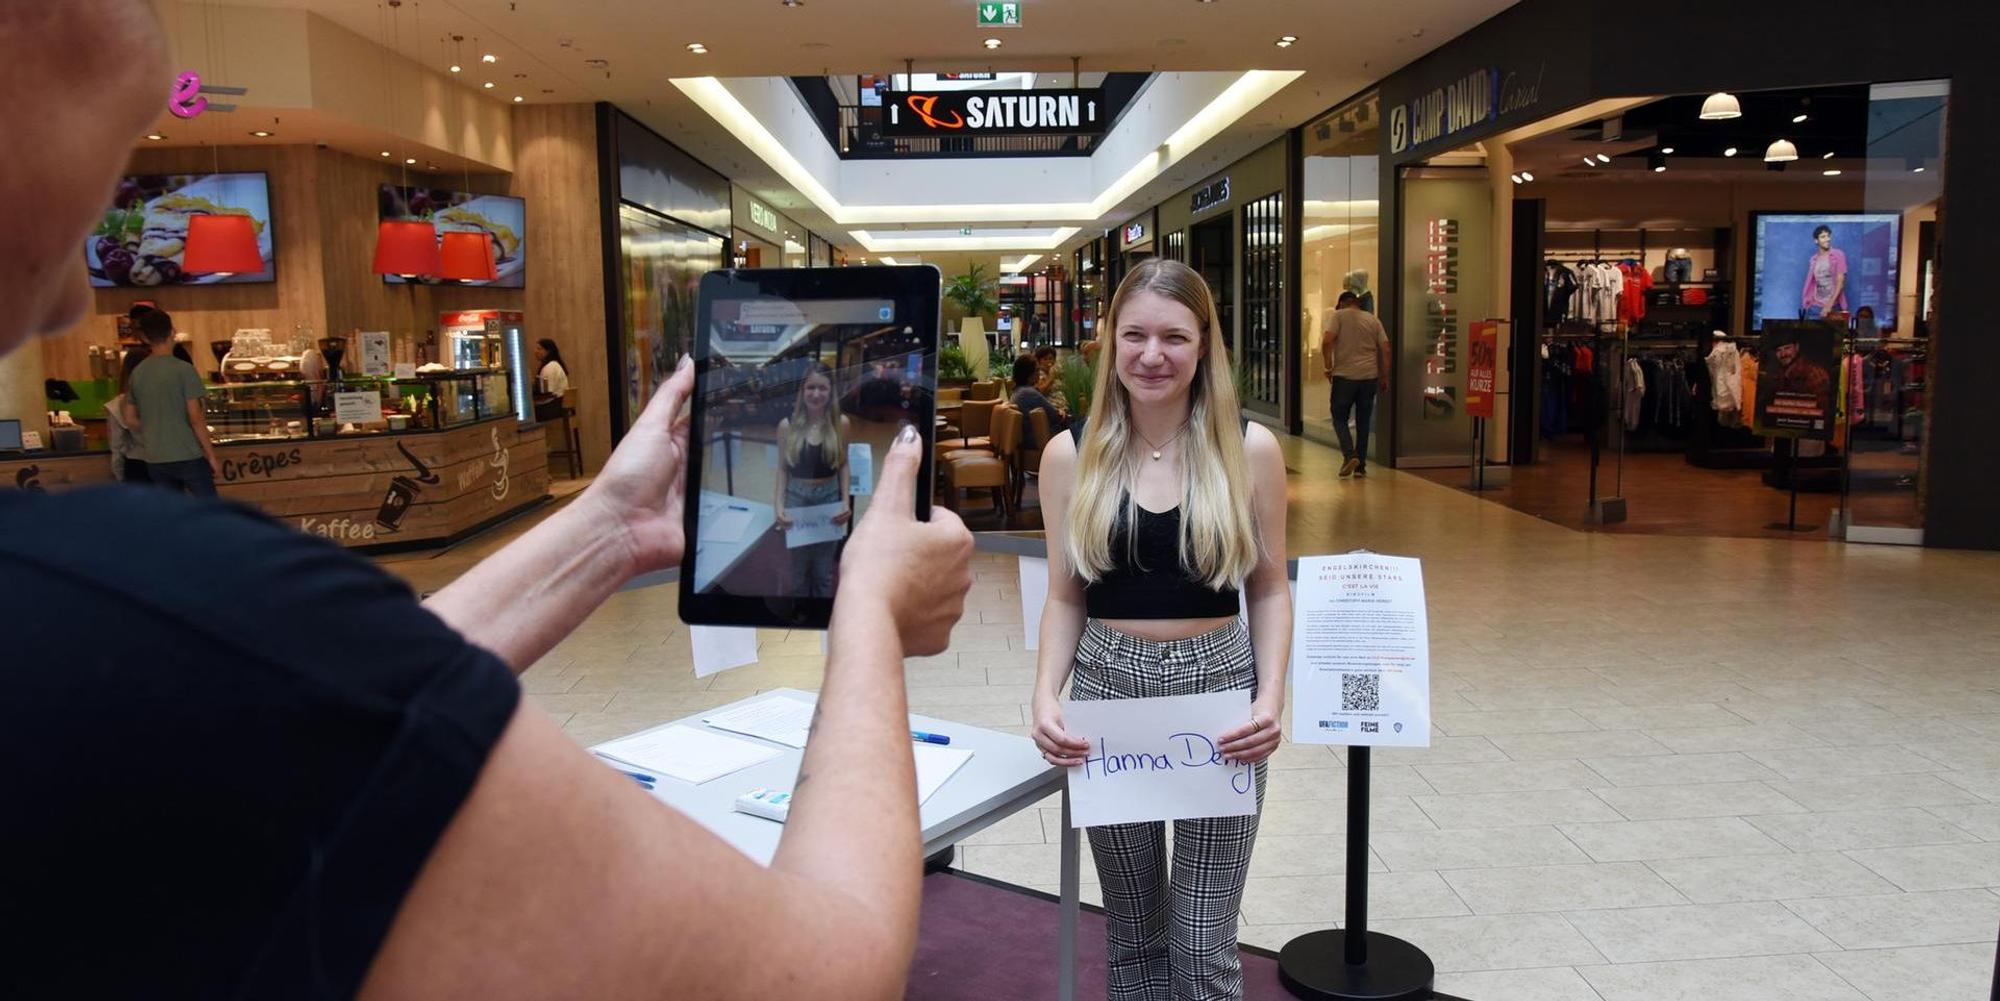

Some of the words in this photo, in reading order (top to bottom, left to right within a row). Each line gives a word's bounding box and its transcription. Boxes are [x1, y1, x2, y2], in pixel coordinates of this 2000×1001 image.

[966, 96, 1079, 128] SATURN
[1412, 87, 1444, 145] CAMP
[1447, 69, 1487, 134] DAVID
[222, 447, 301, 482] Crêpes
[301, 518, 375, 540] Kaffee
[1085, 736, 1174, 779] Hanna
